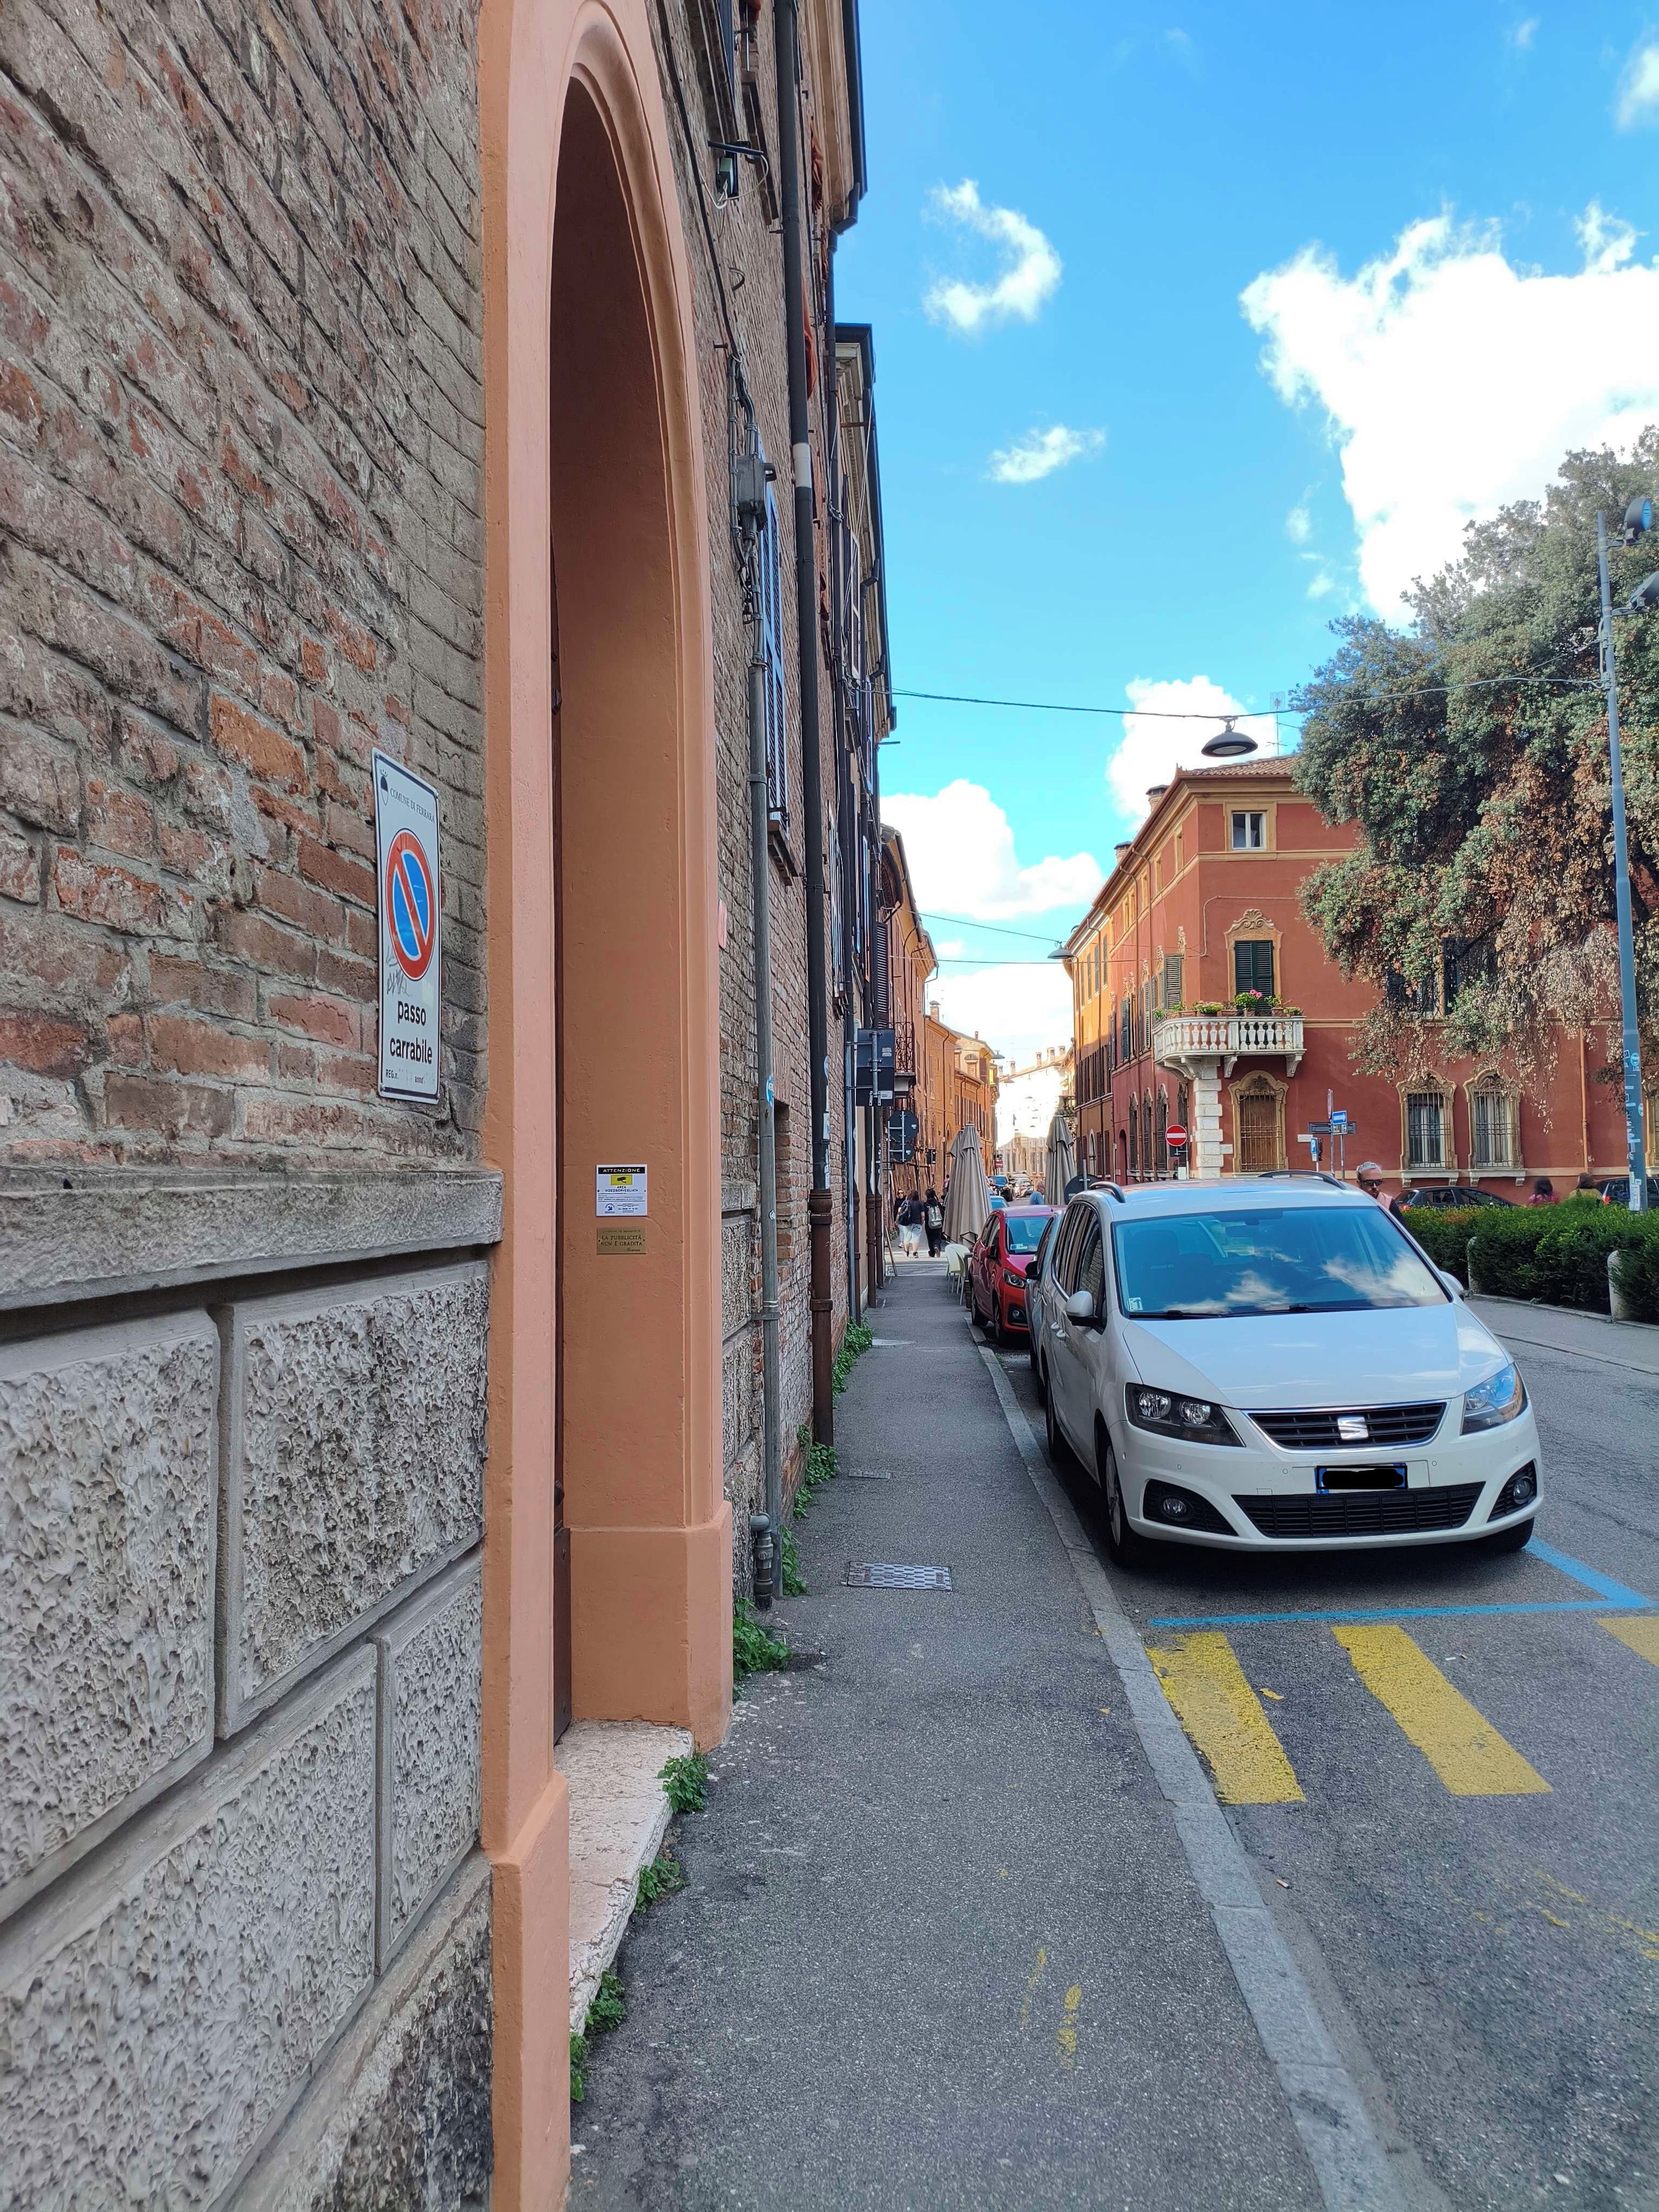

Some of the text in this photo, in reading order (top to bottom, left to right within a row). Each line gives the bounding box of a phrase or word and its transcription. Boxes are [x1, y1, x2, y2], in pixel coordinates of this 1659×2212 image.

[390, 787, 435, 823] COMUNE DI FERRARA
[397, 1001, 426, 1027] passo
[390, 1037, 433, 1065] carrabile
